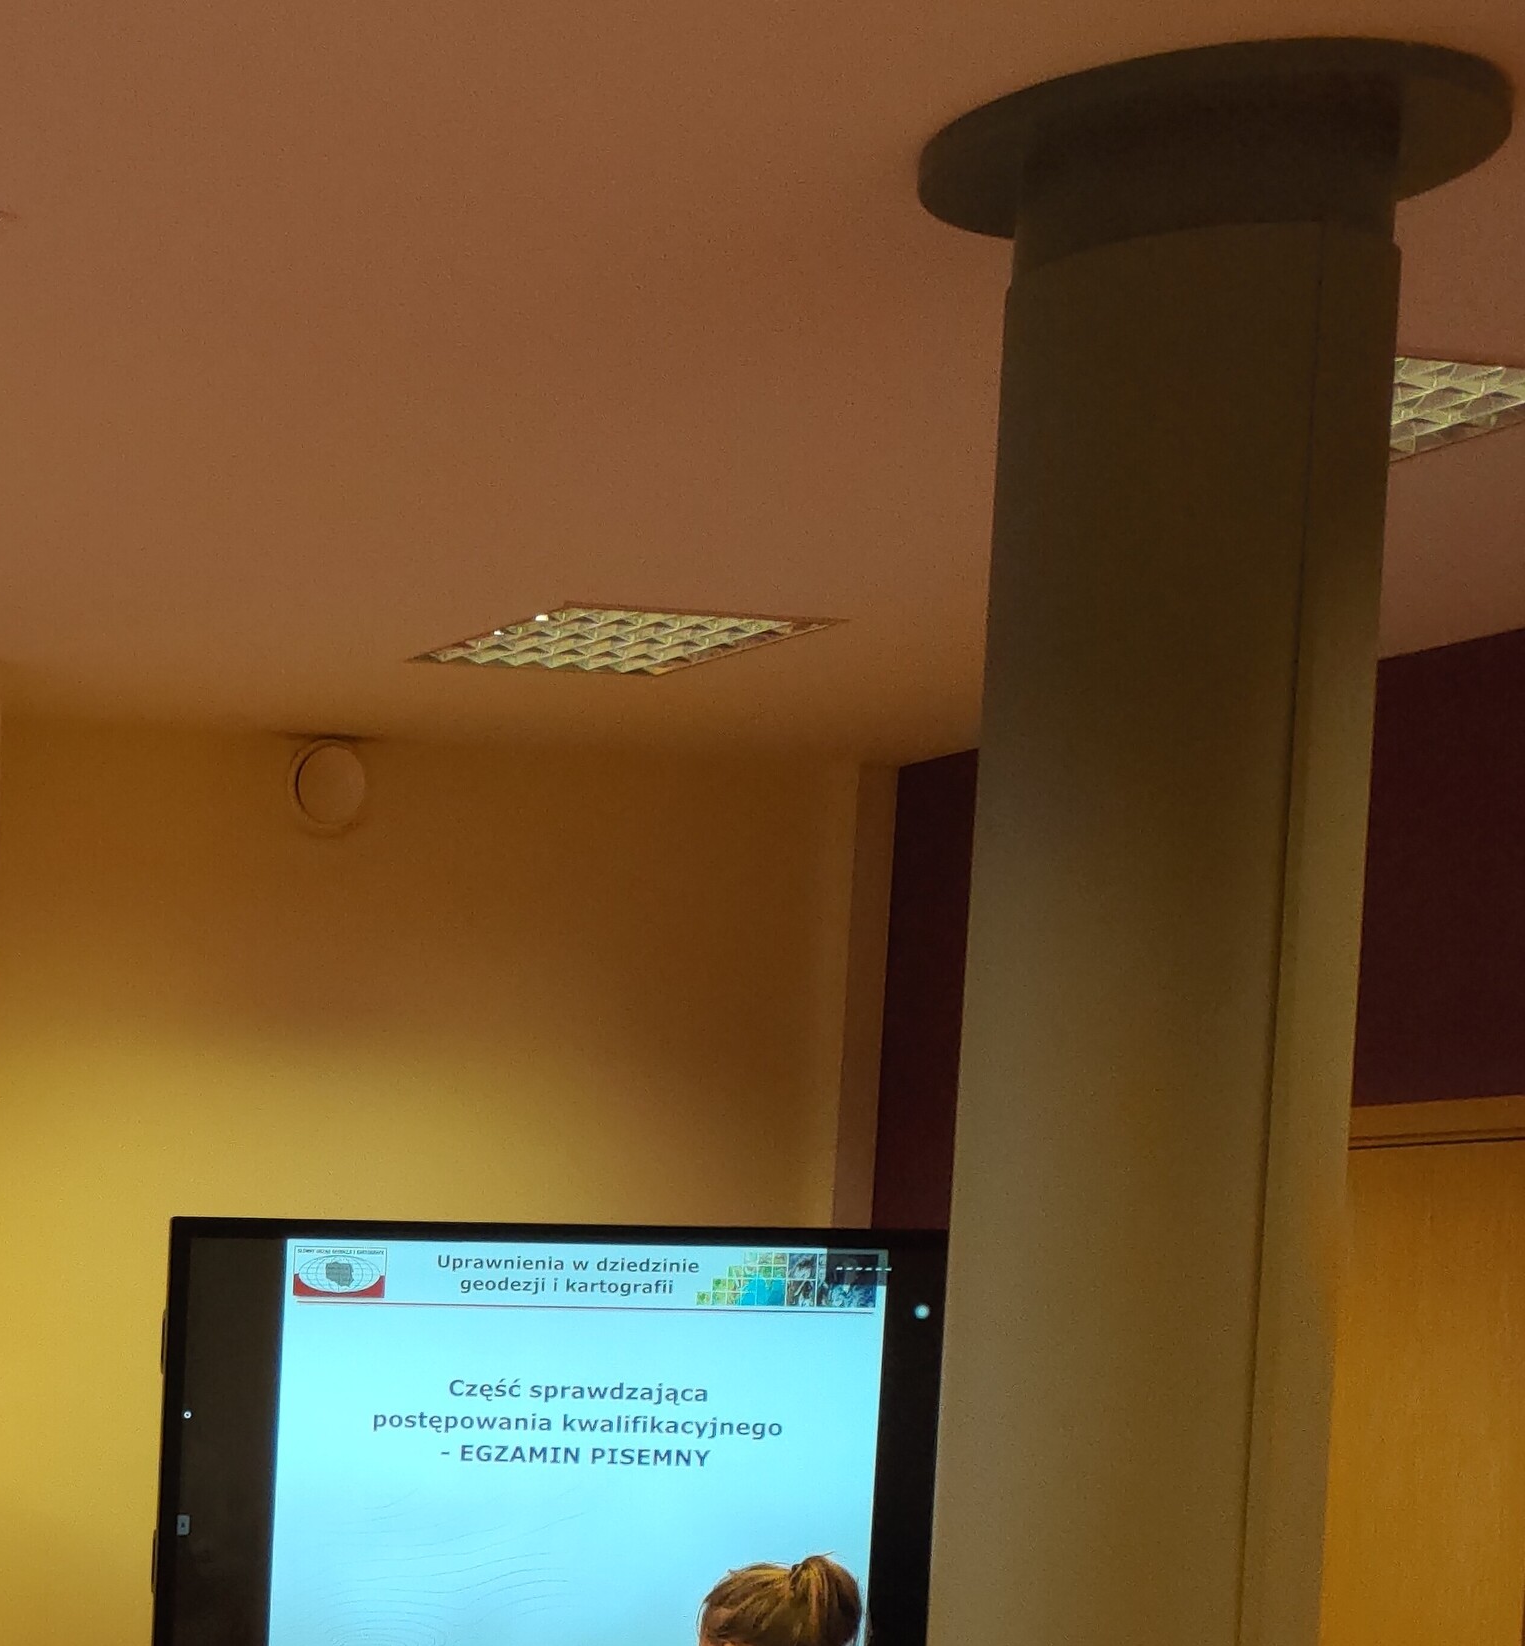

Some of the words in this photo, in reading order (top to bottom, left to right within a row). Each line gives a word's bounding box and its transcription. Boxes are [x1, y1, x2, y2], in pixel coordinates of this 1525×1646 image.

[437, 1254, 564, 1272] Uprawnienia
[572, 1258, 589, 1272] w
[596, 1257, 700, 1274] dziedzinie
[460, 1276, 546, 1296] geodezji
[552, 1278, 559, 1293] i
[565, 1278, 674, 1297] kartografii
[449, 1378, 522, 1402] Część
[529, 1382, 709, 1406] sprawdzająca
[373, 1411, 552, 1434] postępowania
[562, 1413, 783, 1440] kwalifikacyjnego
[460, 1444, 580, 1465] EGZAMIN
[590, 1447, 711, 1467] PISEMNY
